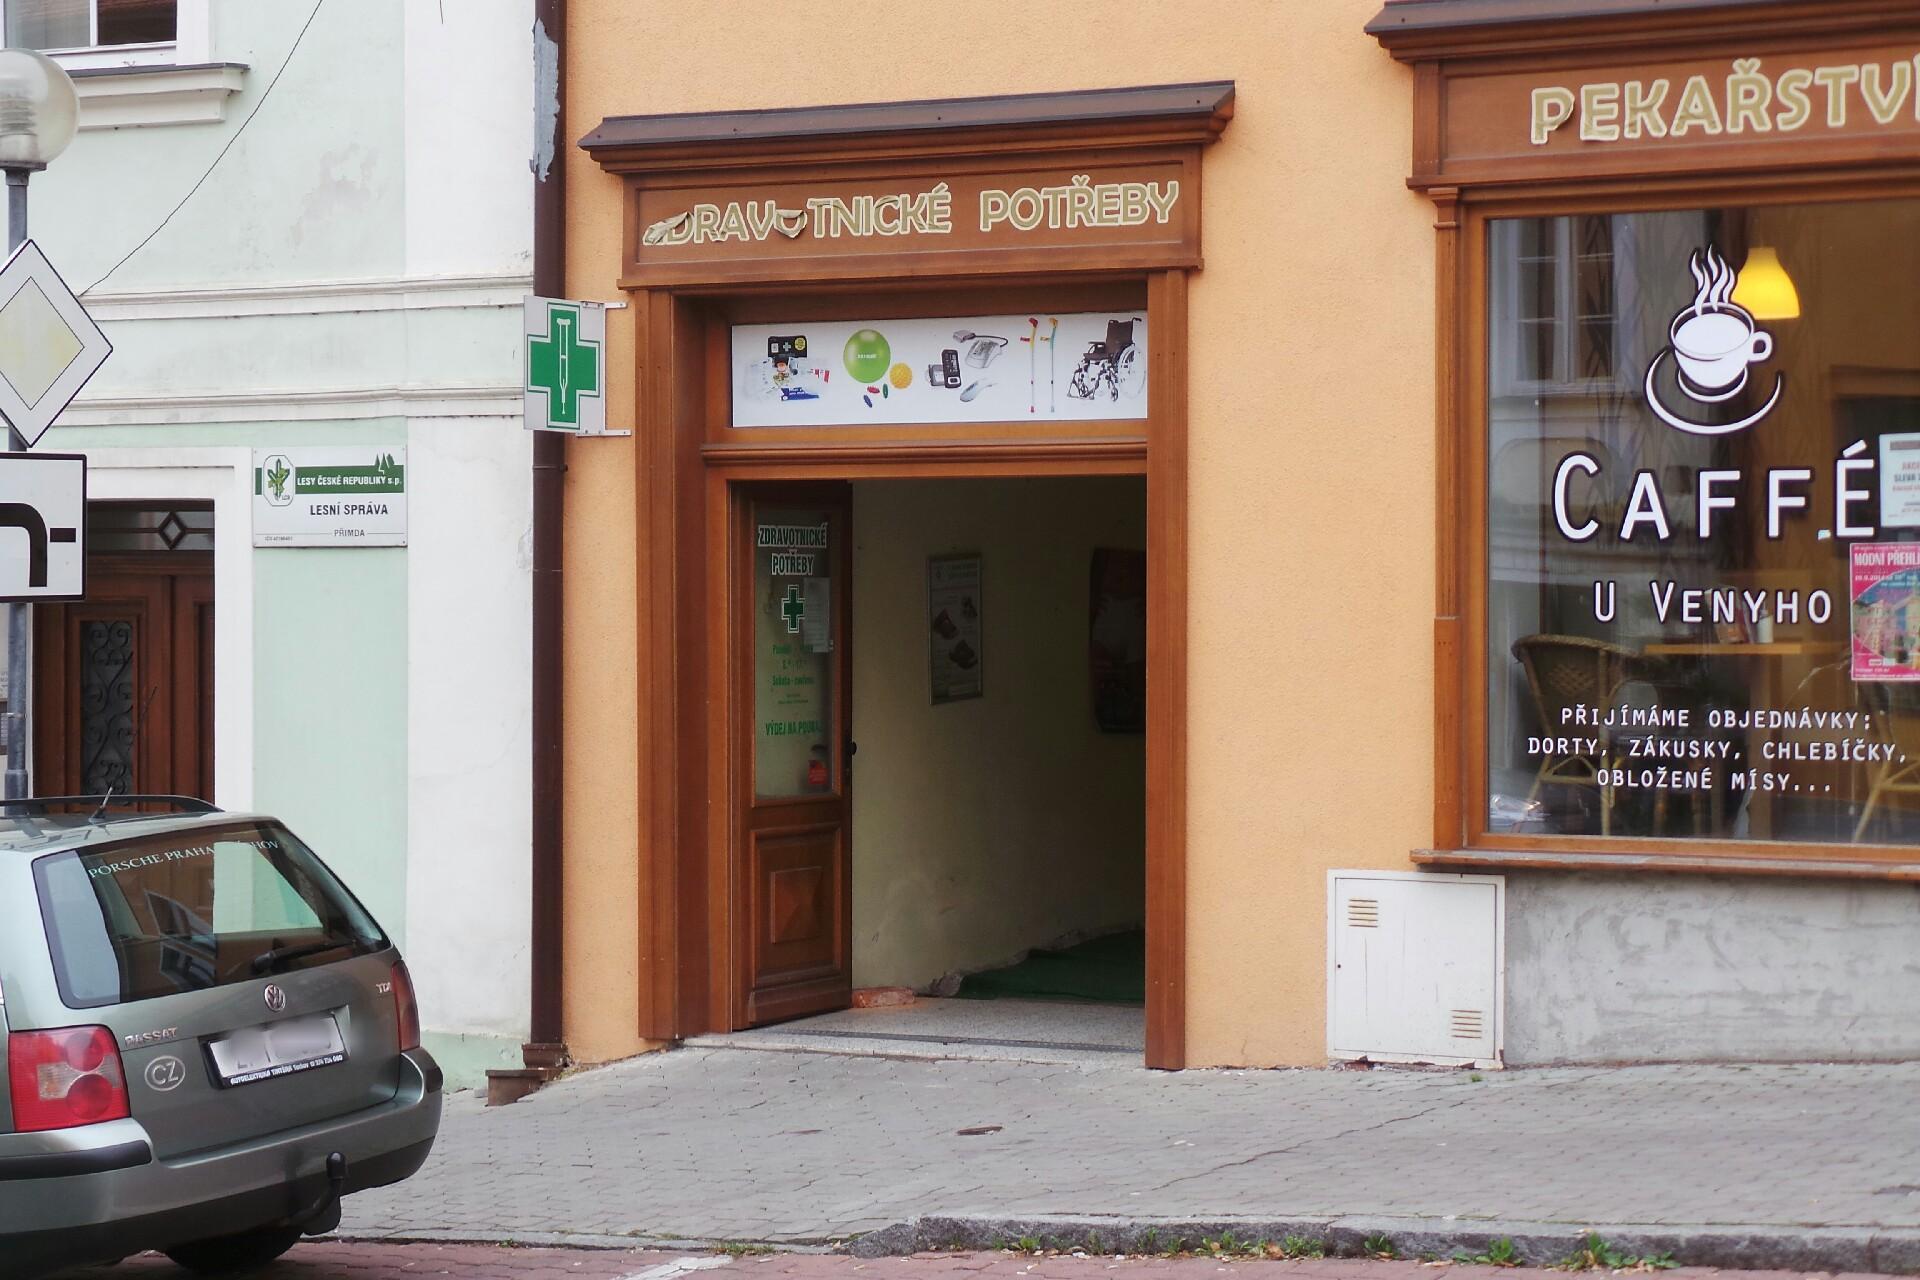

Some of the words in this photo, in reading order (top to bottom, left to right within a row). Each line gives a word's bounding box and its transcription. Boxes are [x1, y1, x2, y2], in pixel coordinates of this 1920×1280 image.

[979, 174, 1179, 233] POTŘEBY
[297, 476, 316, 486] LESY
[317, 474, 341, 486] ČESKÉ
[342, 475, 386, 485] REPUBLIKY
[1554, 439, 1875, 541] CAFFÉ
[310, 501, 340, 516] LESNÍ
[343, 501, 388, 515] SPRÁVA
[334, 527, 365, 537] PŘIMDA
[758, 522, 828, 548] ZDRAVOTNICKÉ
[771, 549, 814, 575] POTŘEBY
[1594, 580, 1616, 623] U
[1650, 580, 1831, 624] VENYHO
[1561, 704, 1690, 727] PŘIJÍMÁME
[1709, 707, 1871, 729] OBJEDNÁVKY:
[1528, 737, 1608, 757] DORTY,
[1629, 735, 1741, 760] ZÁKUSKY,
[1762, 738, 1906, 763] CHLEBÍČKY,
[1597, 766, 1713, 789] OBLOŽENÉ
[1731, 768, 1832, 792] MÍSY...
[88, 854, 164, 879] PORSCHE
[165, 846, 216, 862] PRAHA
[124, 1026, 178, 1048] PASSAT
[152, 1060, 179, 1085] CZ
